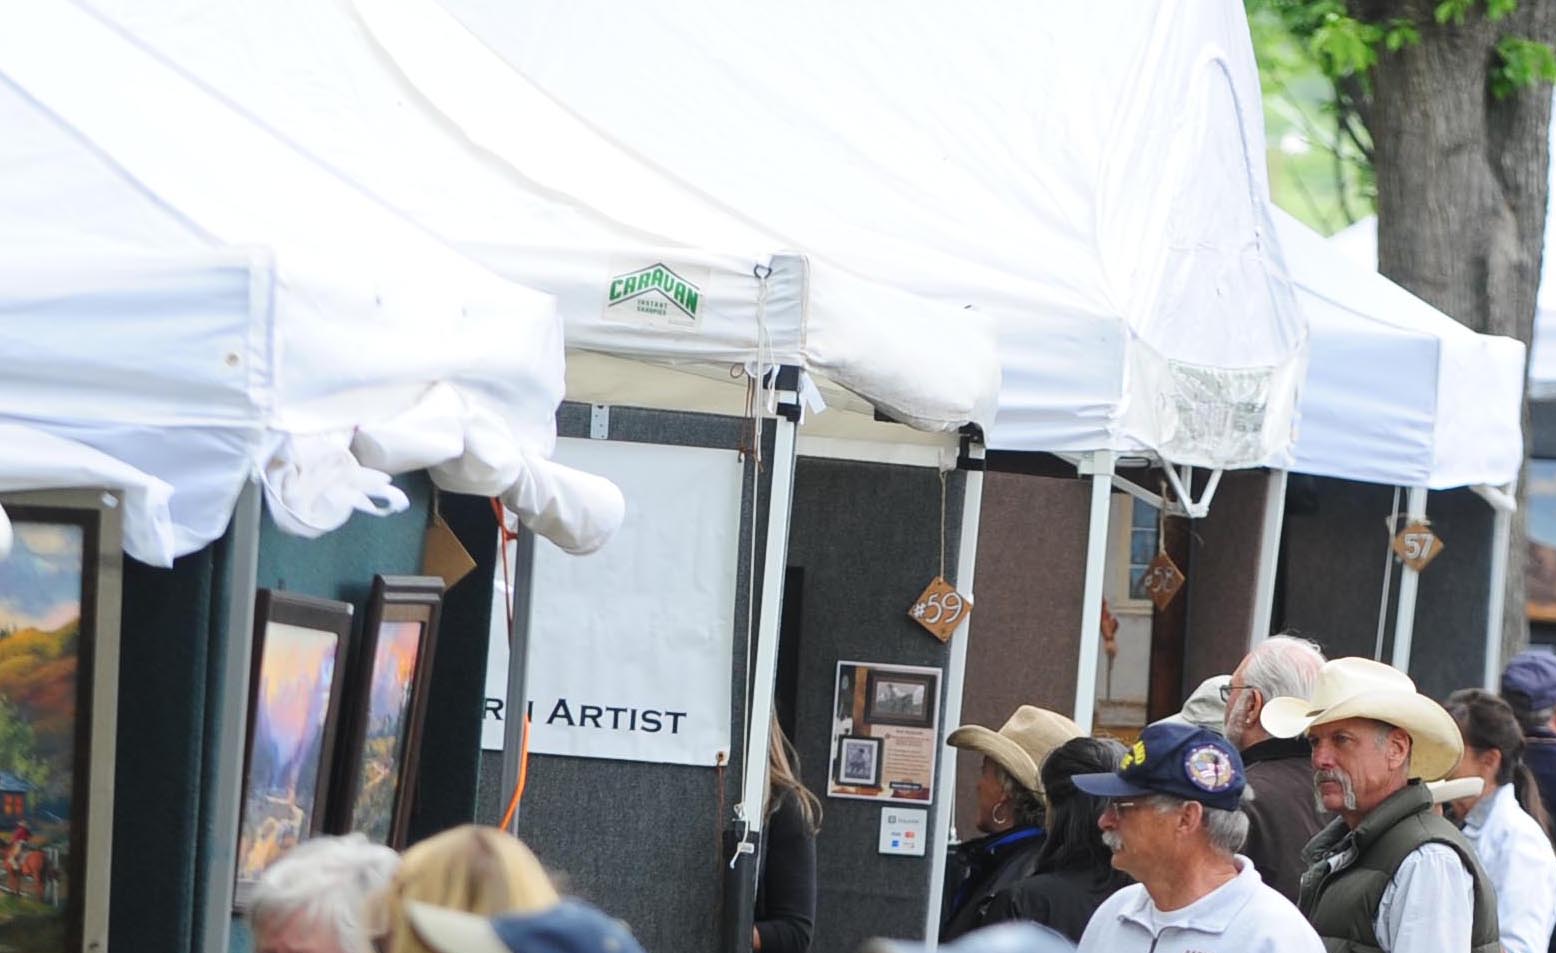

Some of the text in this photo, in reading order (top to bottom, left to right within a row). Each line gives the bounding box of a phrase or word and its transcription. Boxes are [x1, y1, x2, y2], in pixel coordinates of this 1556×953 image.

[608, 267, 699, 315] CARAVAN
[1404, 533, 1434, 559] 57
[911, 591, 962, 624] #59
[546, 698, 687, 735] ARTIST
